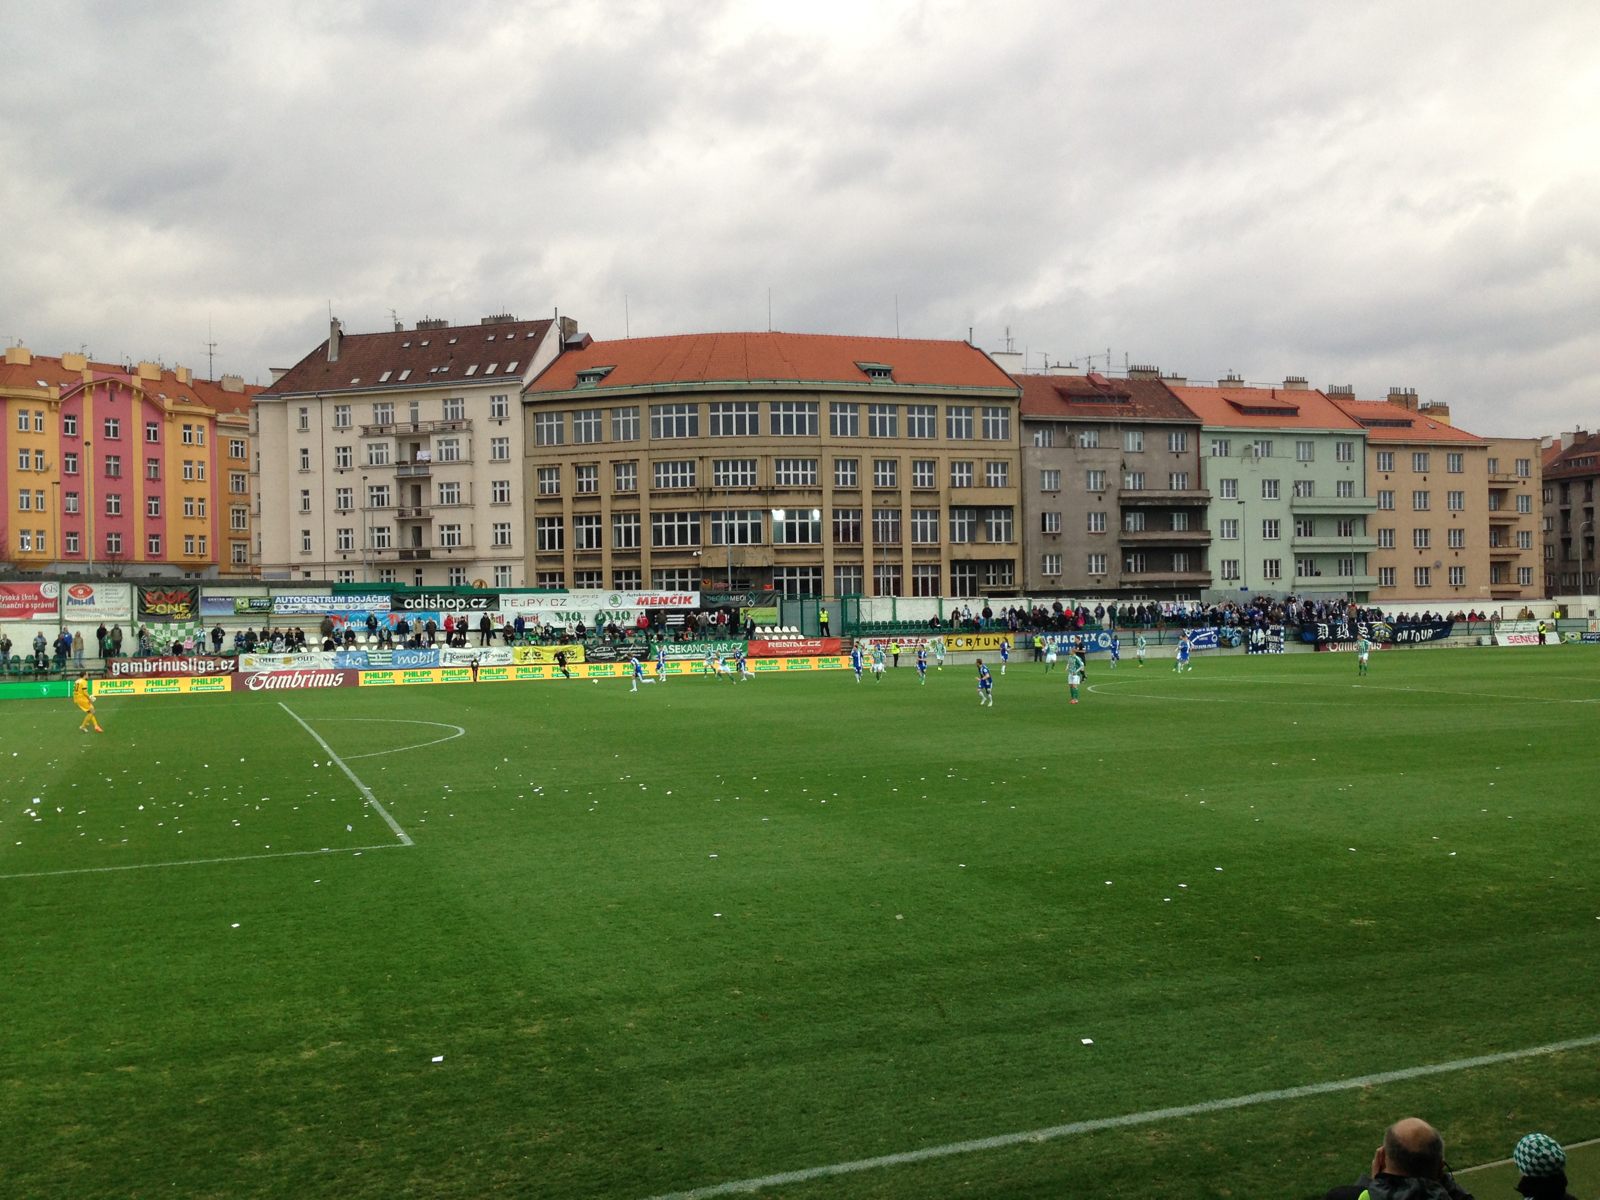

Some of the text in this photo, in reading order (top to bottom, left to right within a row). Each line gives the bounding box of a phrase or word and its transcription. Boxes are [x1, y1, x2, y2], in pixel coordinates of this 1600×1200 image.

[348, 594, 390, 603] DOJÁČEK
[404, 594, 487, 612] adishop.cz
[31, 601, 54, 610] správní
[145, 603, 191, 614] ZONE
[947, 636, 1007, 647] FORTUN
[397, 651, 435, 664] mobil
[112, 658, 235, 675] gambrinusliga.cz
[365, 671, 394, 679] PHILIPP
[480, 667, 507, 675] PHILIPP
[100, 677, 224, 688] PHILIPP PHILIPP PHILIPP
[245, 670, 345, 691] Gambrinus
